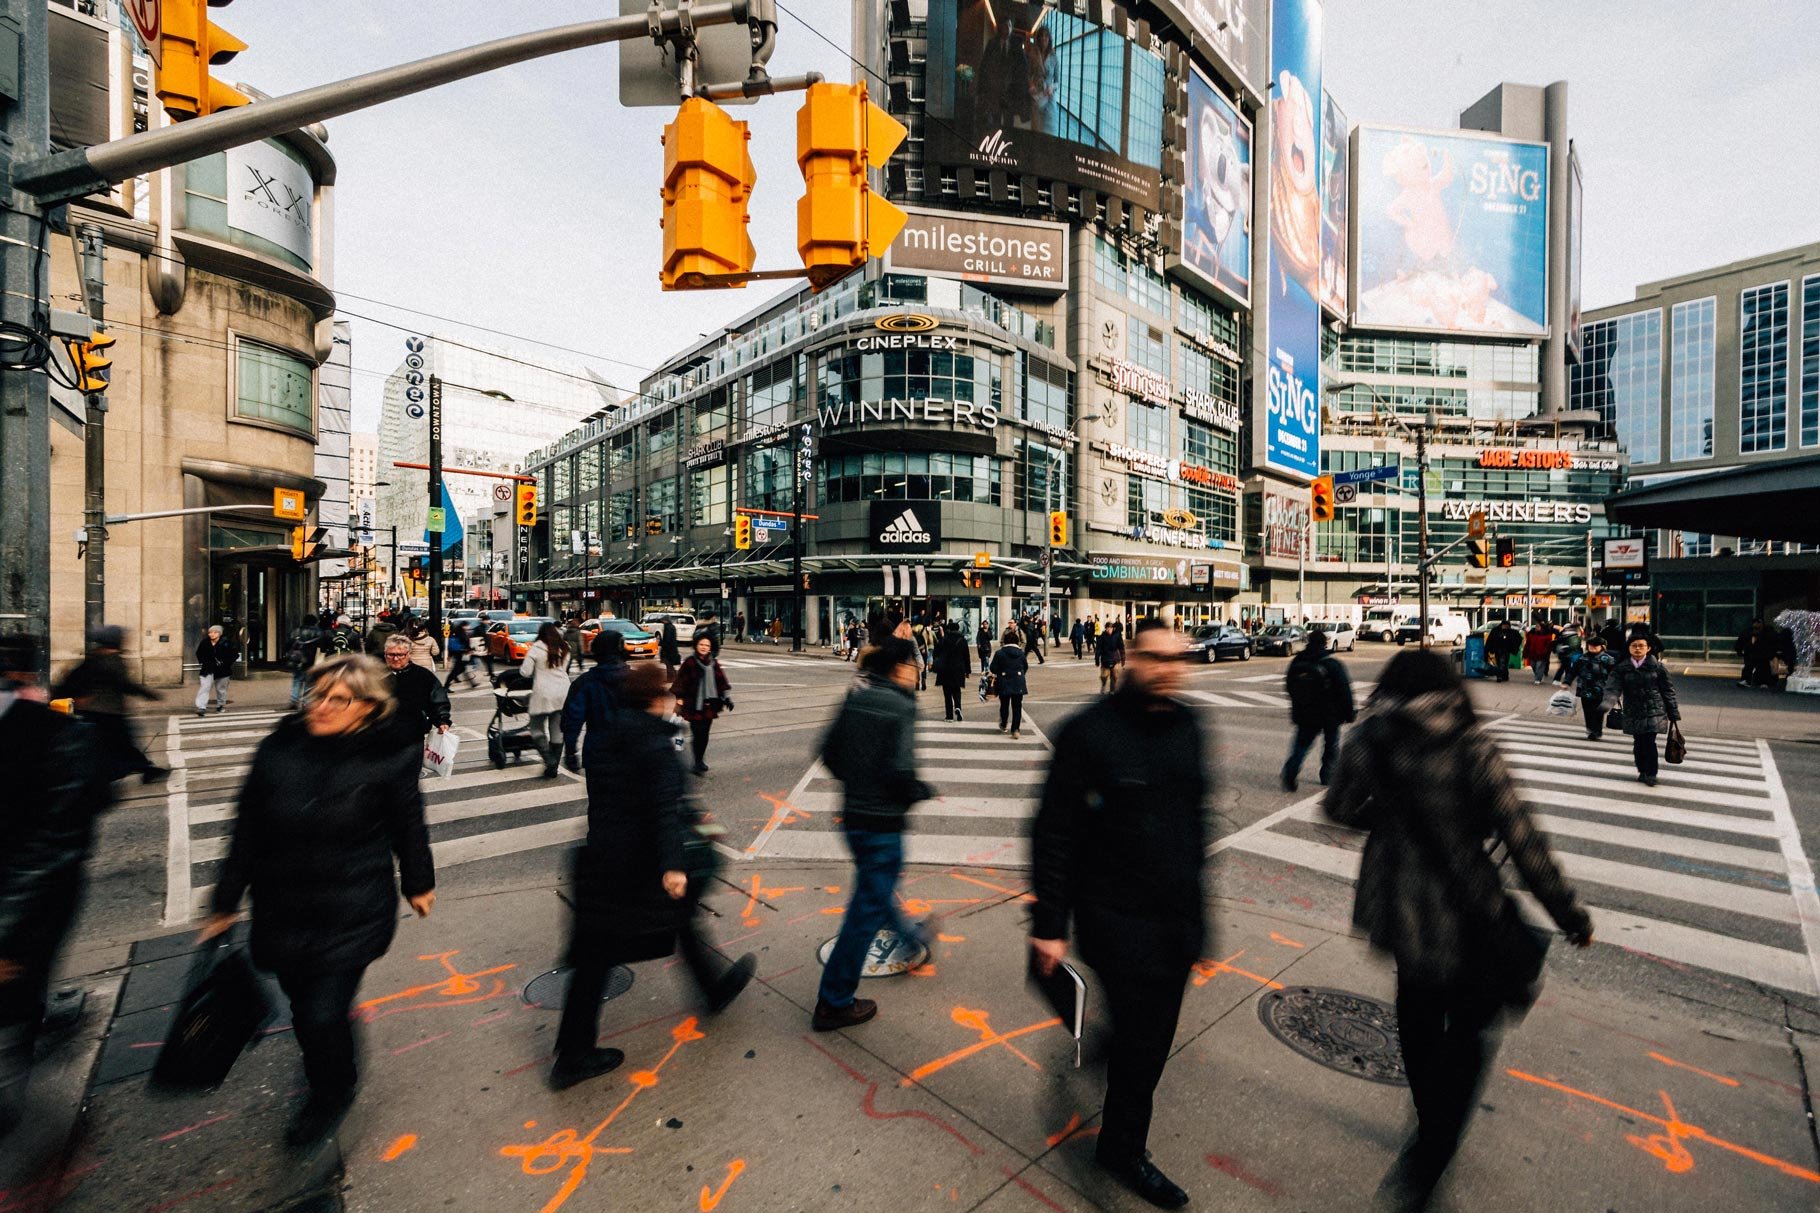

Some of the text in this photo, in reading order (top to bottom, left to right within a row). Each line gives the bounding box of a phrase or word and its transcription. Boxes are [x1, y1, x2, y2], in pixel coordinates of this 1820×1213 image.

[979, 129, 1013, 165] Mr.
[1087, 159, 1099, 167] NEW
[1470, 162, 1541, 202] SING
[904, 225, 1051, 261] milestones
[964, 259, 1006, 273] GRILL
[857, 335, 957, 350] CINEPLEX
[432, 382, 440, 440] DOWNTOWN
[1186, 386, 1217, 414] SHARK
[1217, 400, 1239, 423] CLUB
[1269, 366, 1317, 435] SING
[817, 397, 998, 428] WINNERS
[744, 421, 787, 442] milestones
[688, 444, 707, 460] SHARK
[800, 423, 812, 481] Yonge
[1109, 443, 1167, 468] SHOPPERS
[1480, 450, 1514, 468] JACK
[1517, 451, 1573, 469] ASTOR'S
[1349, 471, 1376, 481] Yonge
[363, 511, 372, 535] Actin
[759, 520, 777, 528] Dundas
[1447, 501, 1591, 524] WINNERS
[880, 531, 931, 544] adidas
[1151, 526, 1206, 549] CINEPLEX
[1093, 557, 1109, 565] FOOD
